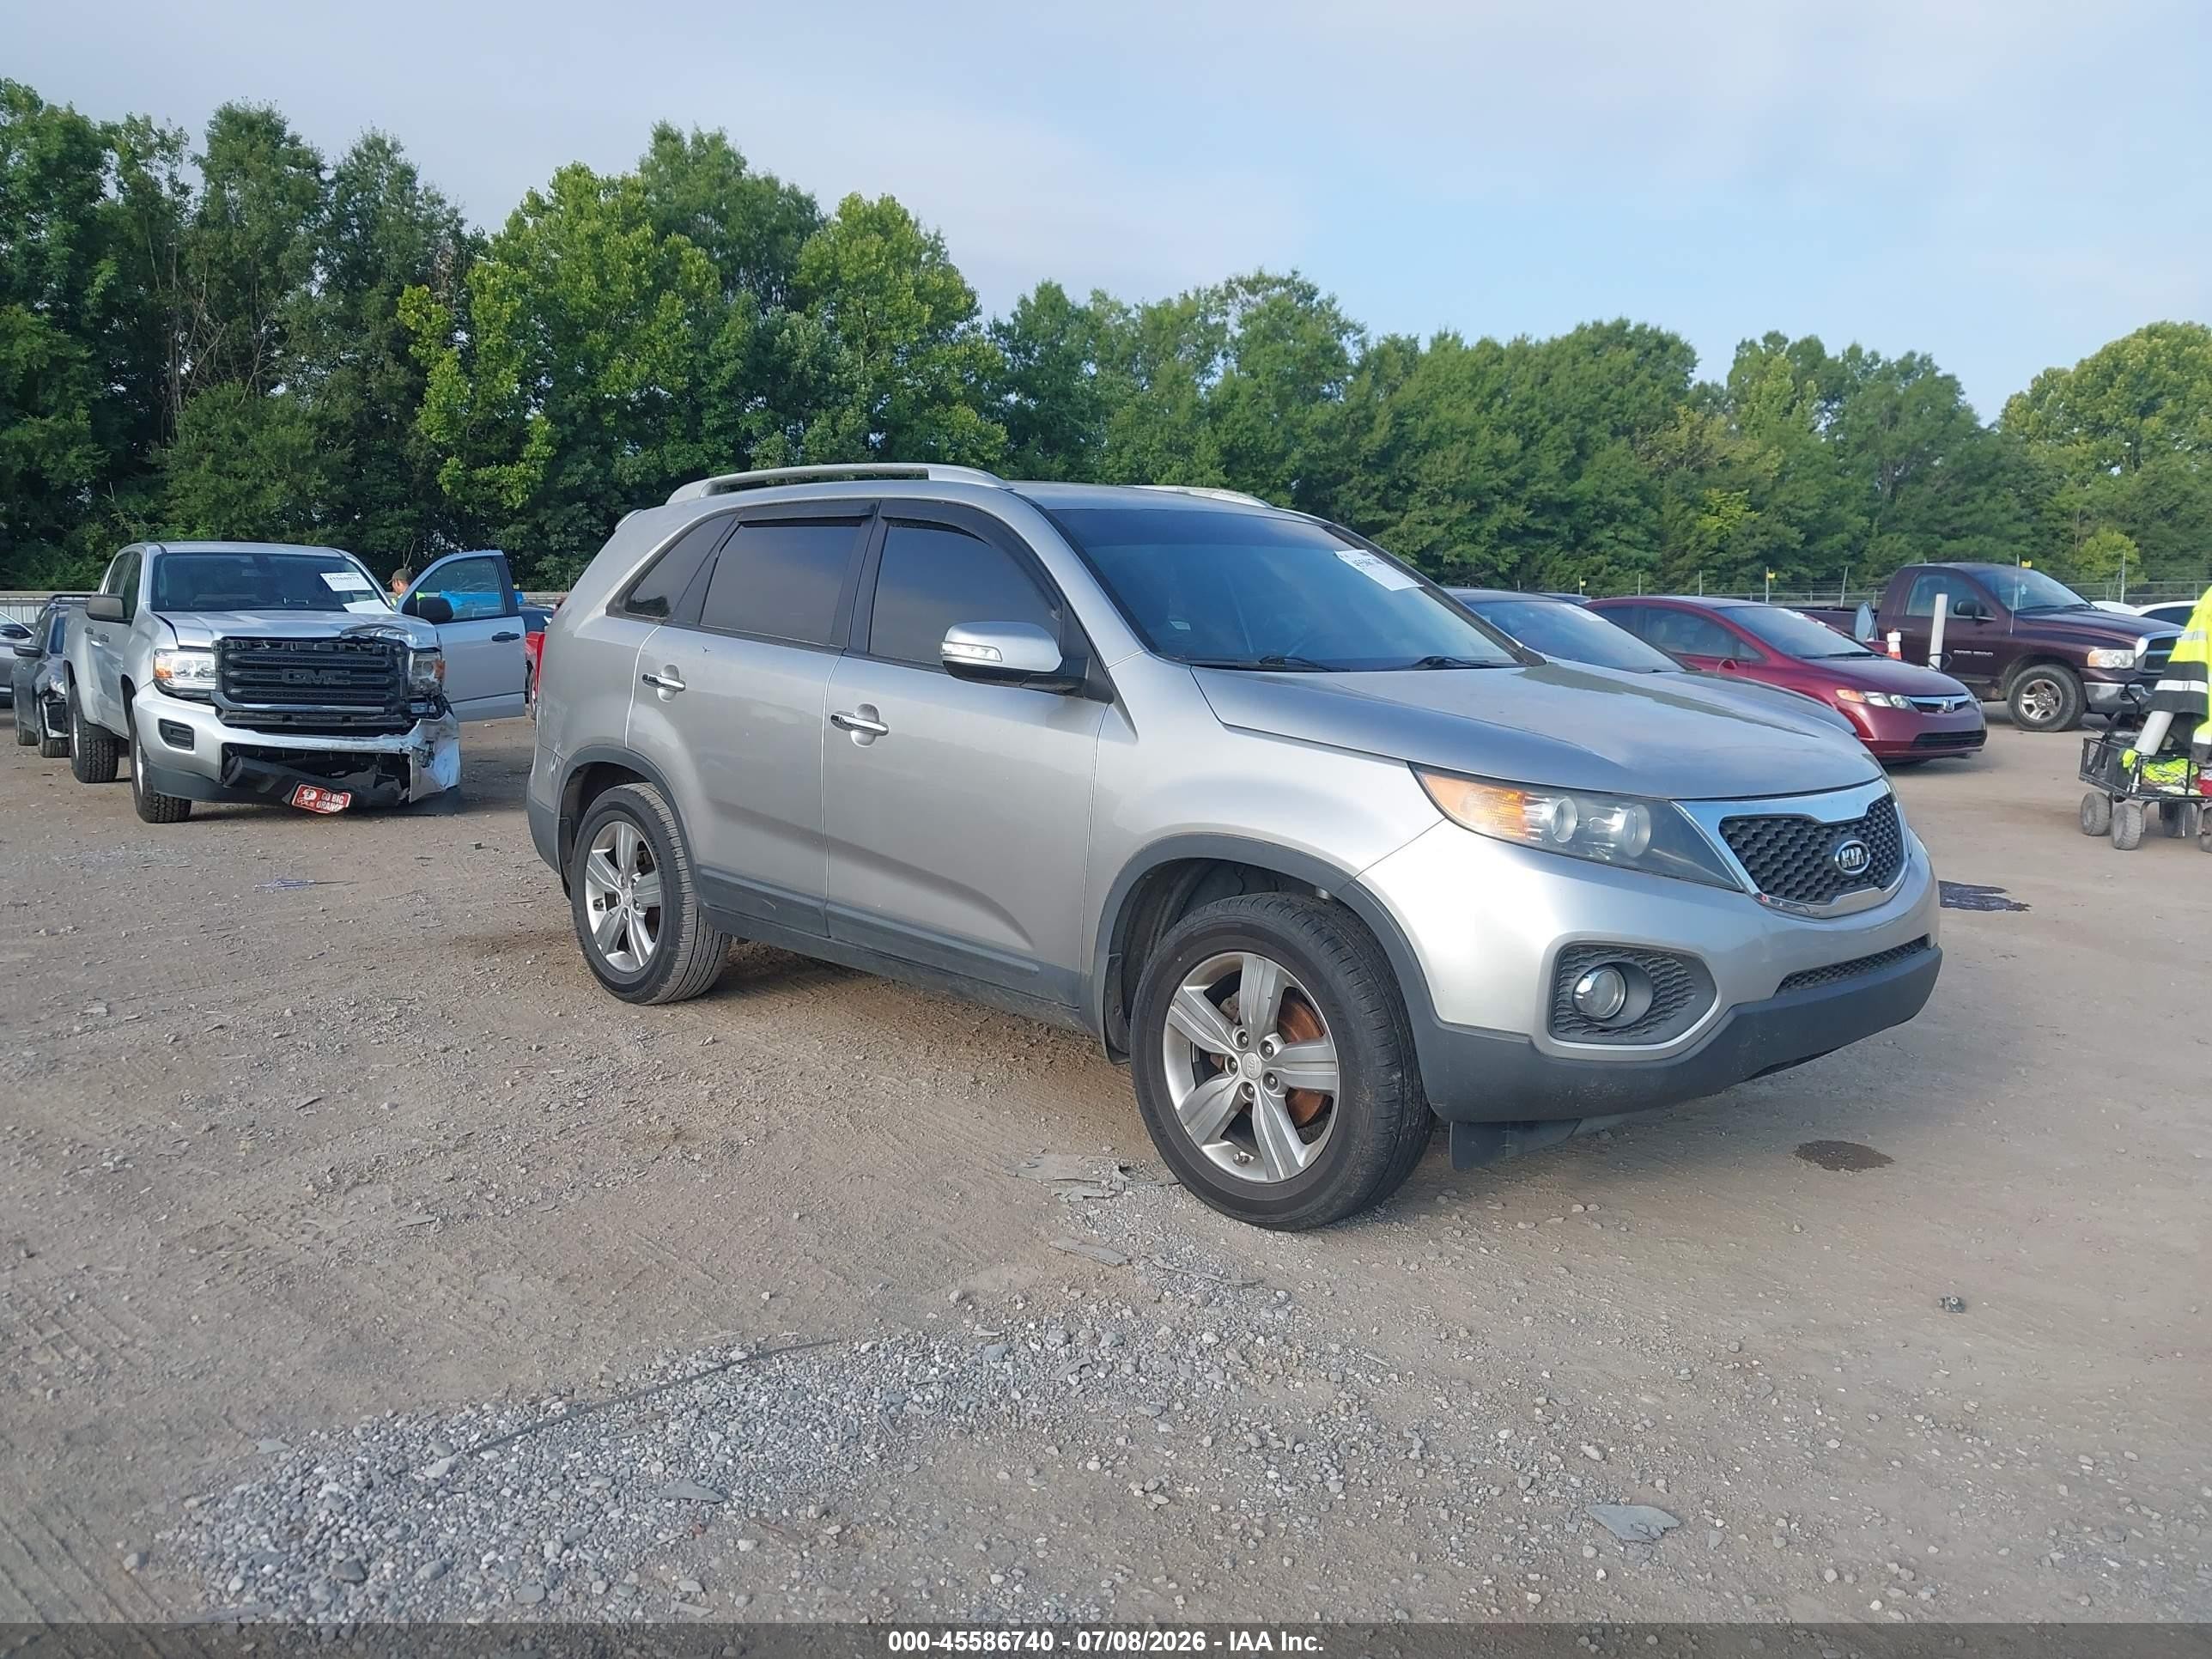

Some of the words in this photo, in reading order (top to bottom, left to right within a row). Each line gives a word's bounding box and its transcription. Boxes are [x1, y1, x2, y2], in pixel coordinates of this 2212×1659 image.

[282, 669, 350, 684] GMC
[331, 793, 344, 805] BIG
[1841, 847, 1864, 868] KIA
